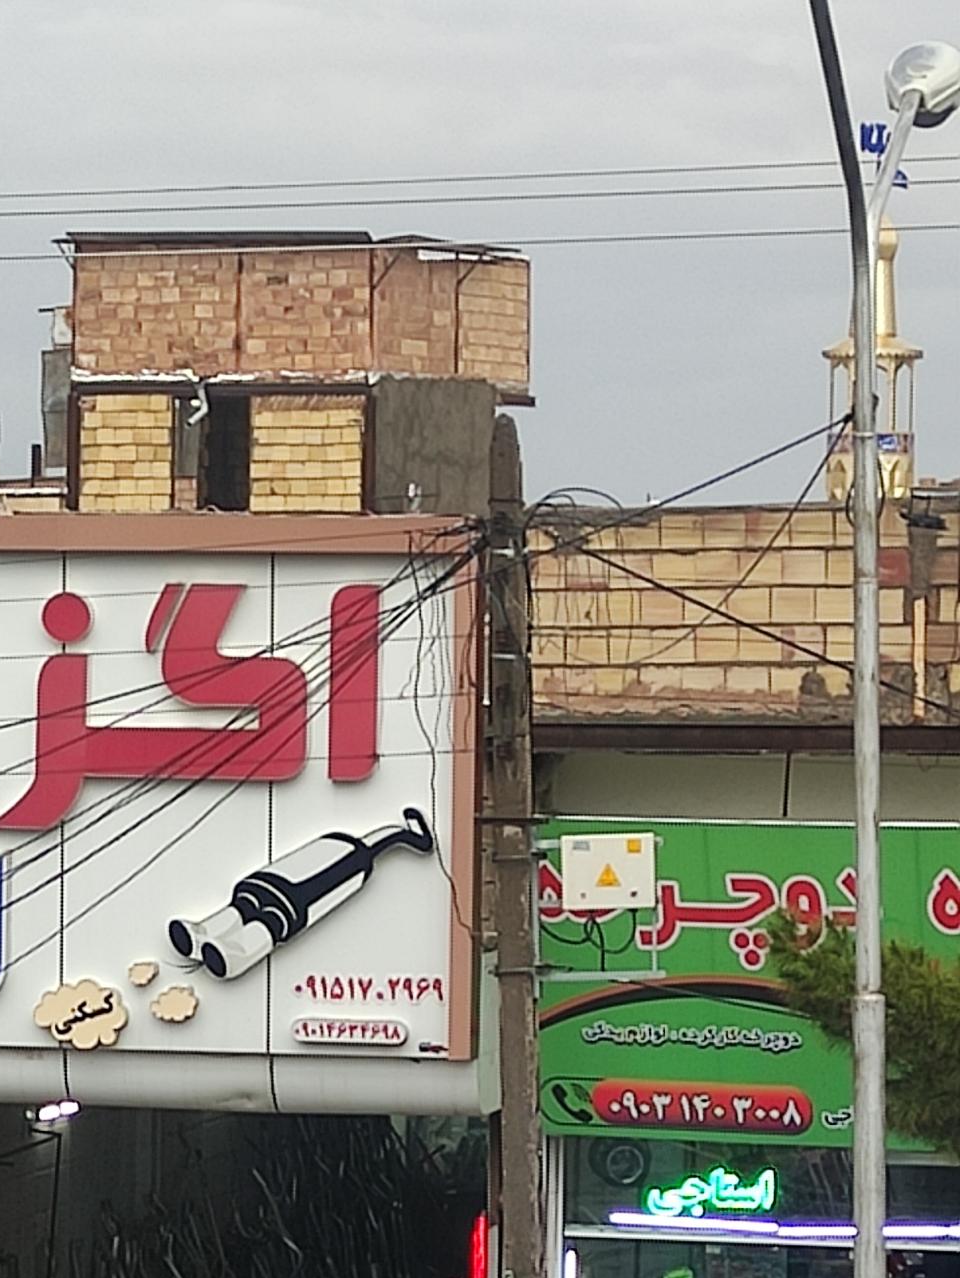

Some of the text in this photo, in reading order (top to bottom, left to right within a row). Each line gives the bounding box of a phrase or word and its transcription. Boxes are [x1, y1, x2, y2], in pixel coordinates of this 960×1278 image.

[608, 1090, 673, 1121] ۰۹۰۳
[679, 1092, 726, 1123] ۱۴۰
[732, 1096, 803, 1128] ۳۰۰۸
